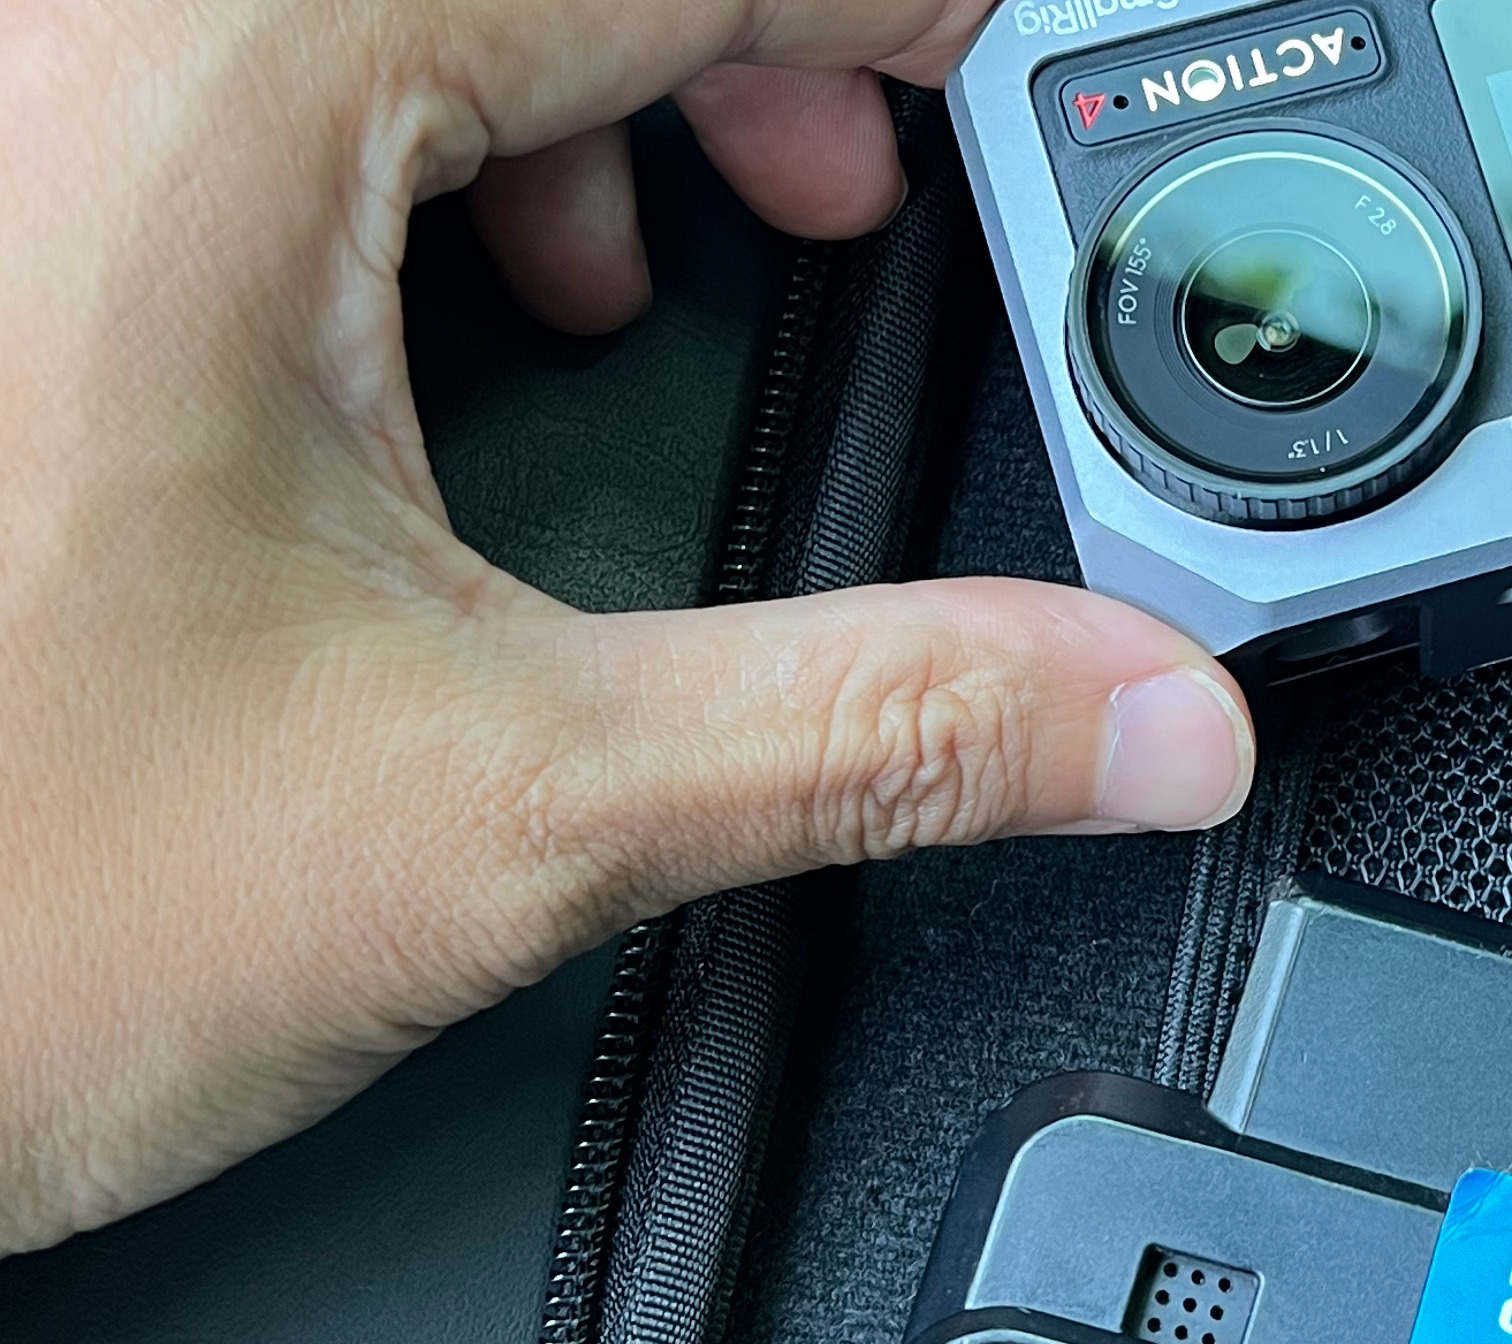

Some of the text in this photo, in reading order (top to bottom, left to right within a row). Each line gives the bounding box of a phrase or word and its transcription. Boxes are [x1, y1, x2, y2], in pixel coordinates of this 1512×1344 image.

[1072, 27, 1345, 131] ACTION 4
[1354, 194, 1371, 210] F
[1117, 280, 1140, 325] FOV
